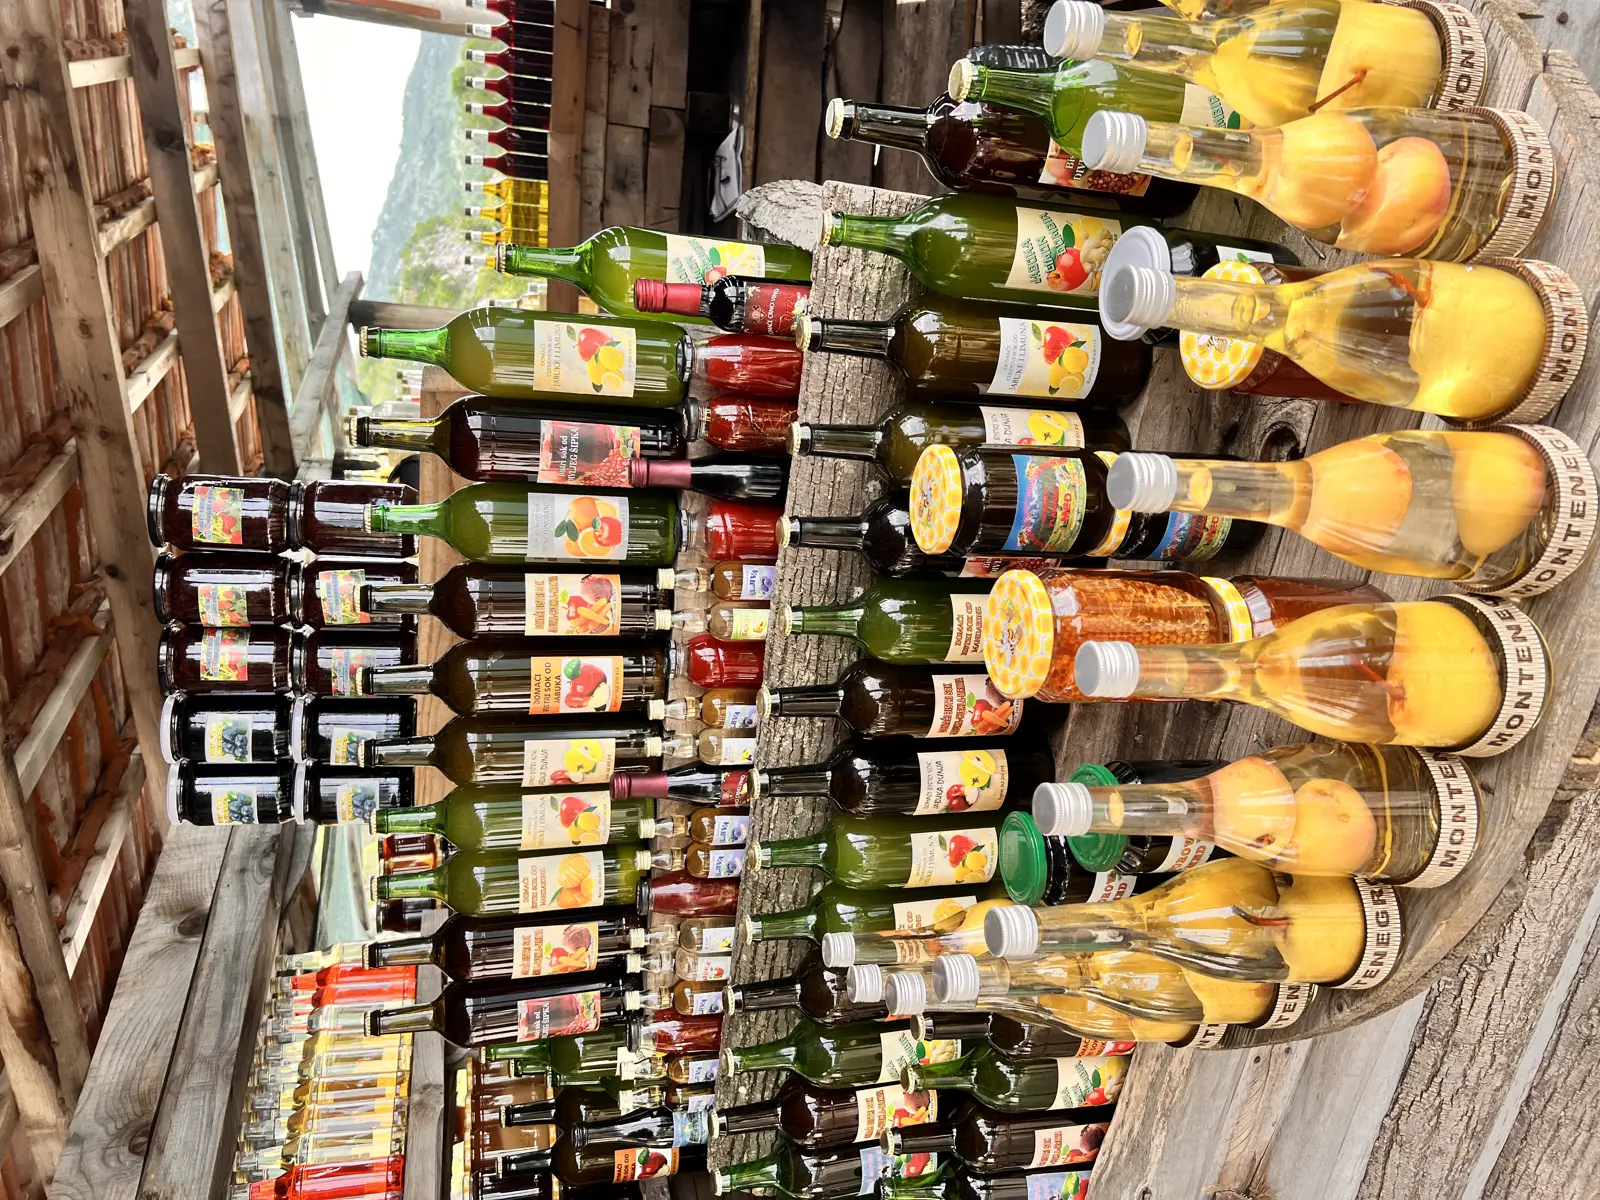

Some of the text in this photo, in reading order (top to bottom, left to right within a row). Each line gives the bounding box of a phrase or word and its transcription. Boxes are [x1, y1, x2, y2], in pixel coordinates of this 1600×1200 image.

[1065, 156, 1075, 169] Bis
[1510, 114, 1542, 218] MONTE
[1039, 212, 1066, 256] ĐUMBIR
[770, 288, 779, 301] VINO
[1009, 363, 1024, 390] JABUKE
[1019, 321, 1027, 357] LIMUNA
[569, 428, 579, 453] ŠIPKA
[558, 436, 568, 476] Bistri sok od
[1061, 493, 1072, 522] MED
[748, 570, 758, 596] ŠLJIVA
[965, 602, 972, 614] OD
[954, 615, 964, 646] DOMAĆI
[545, 662, 551, 674] OD
[533, 674, 541, 704] DOMAĆI
[943, 683, 953, 695] SOK
[1430, 751, 1467, 867] MONTEN
[624, 1154, 629, 1163] OD
